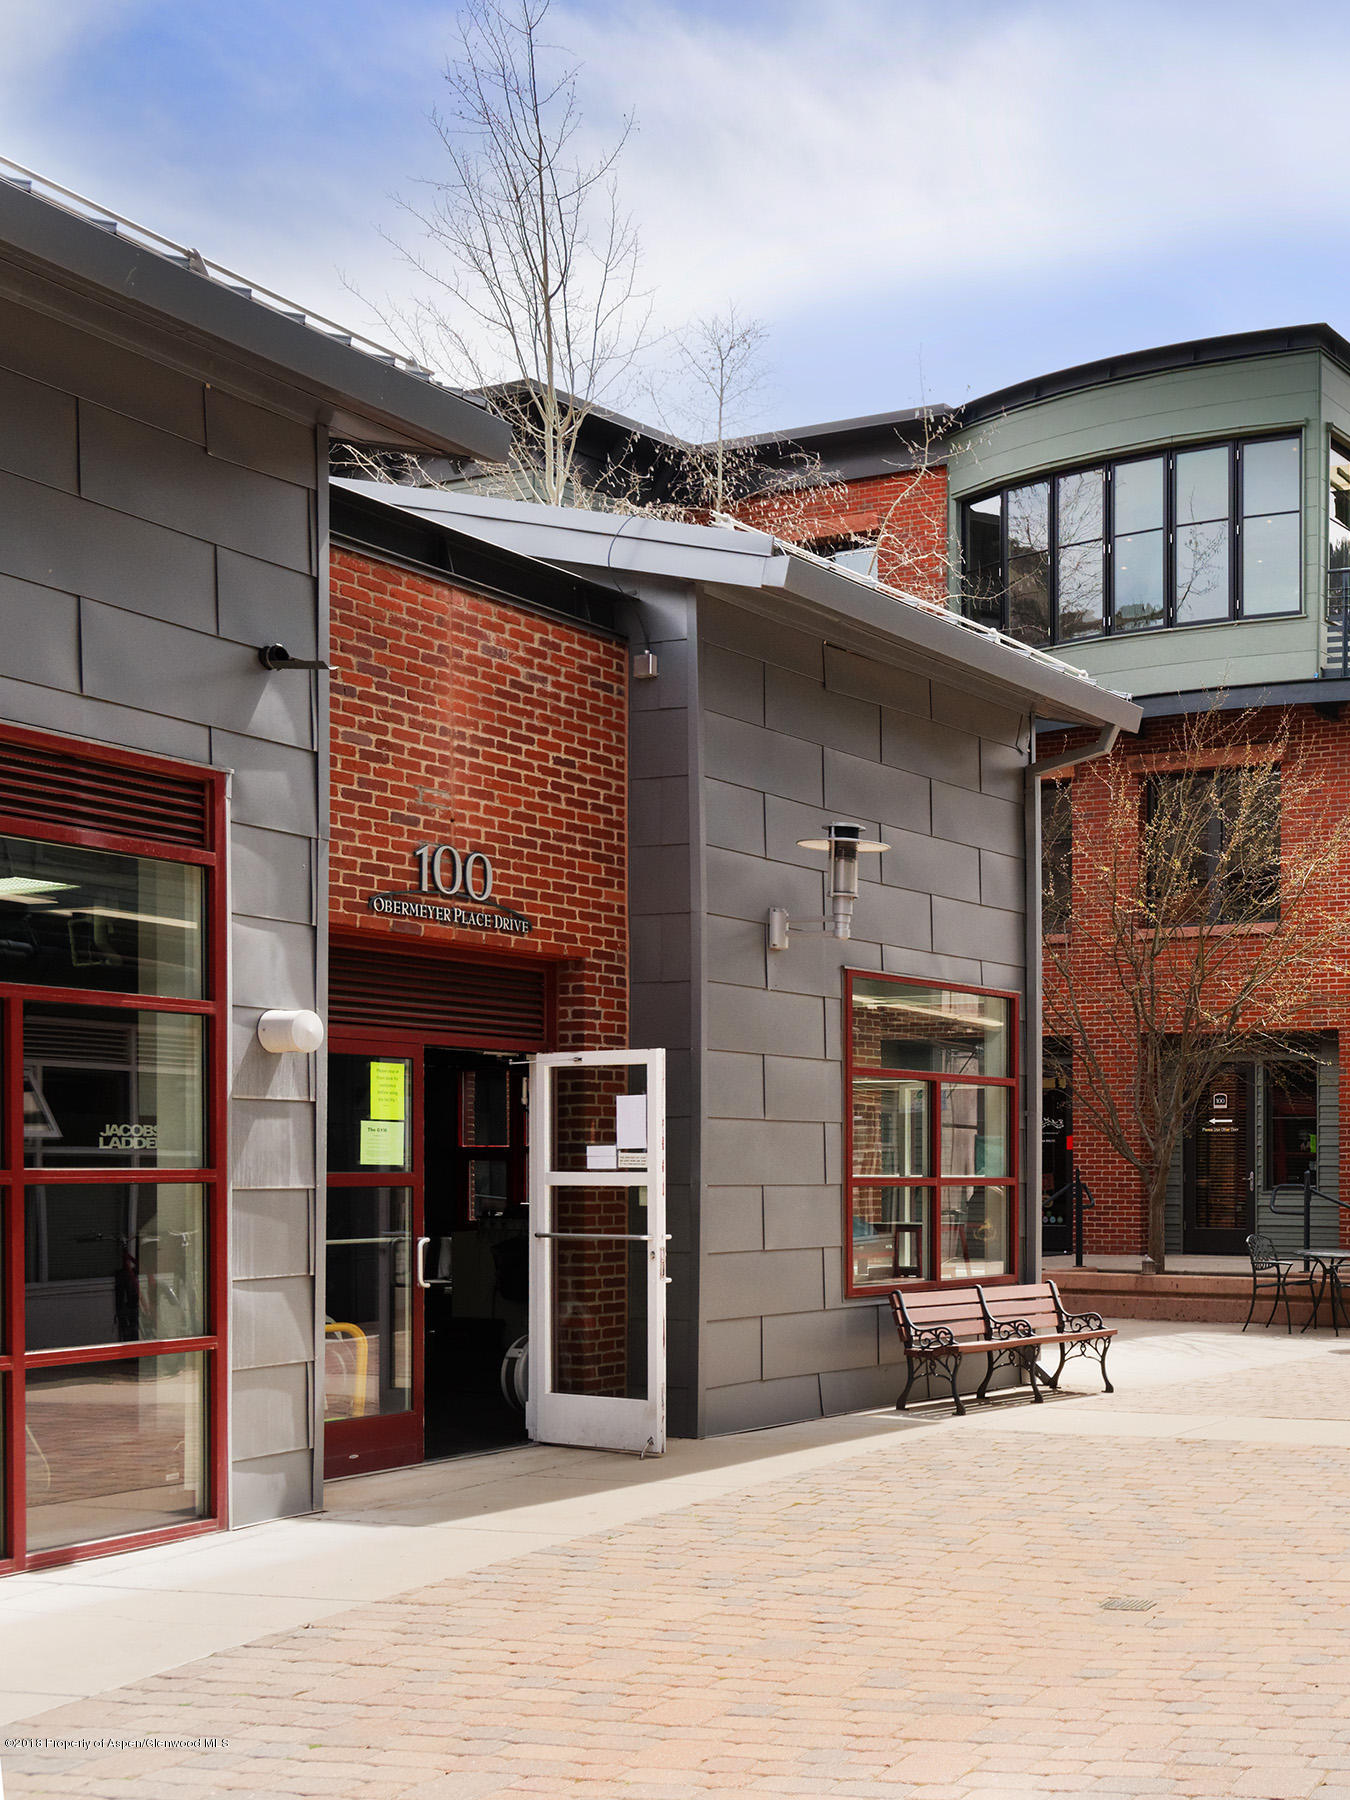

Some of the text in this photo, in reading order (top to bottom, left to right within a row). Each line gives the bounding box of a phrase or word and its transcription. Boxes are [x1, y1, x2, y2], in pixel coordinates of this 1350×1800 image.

[414, 844, 493, 901] 100
[373, 896, 529, 934] OBERMEYER PLACE DRIVE
